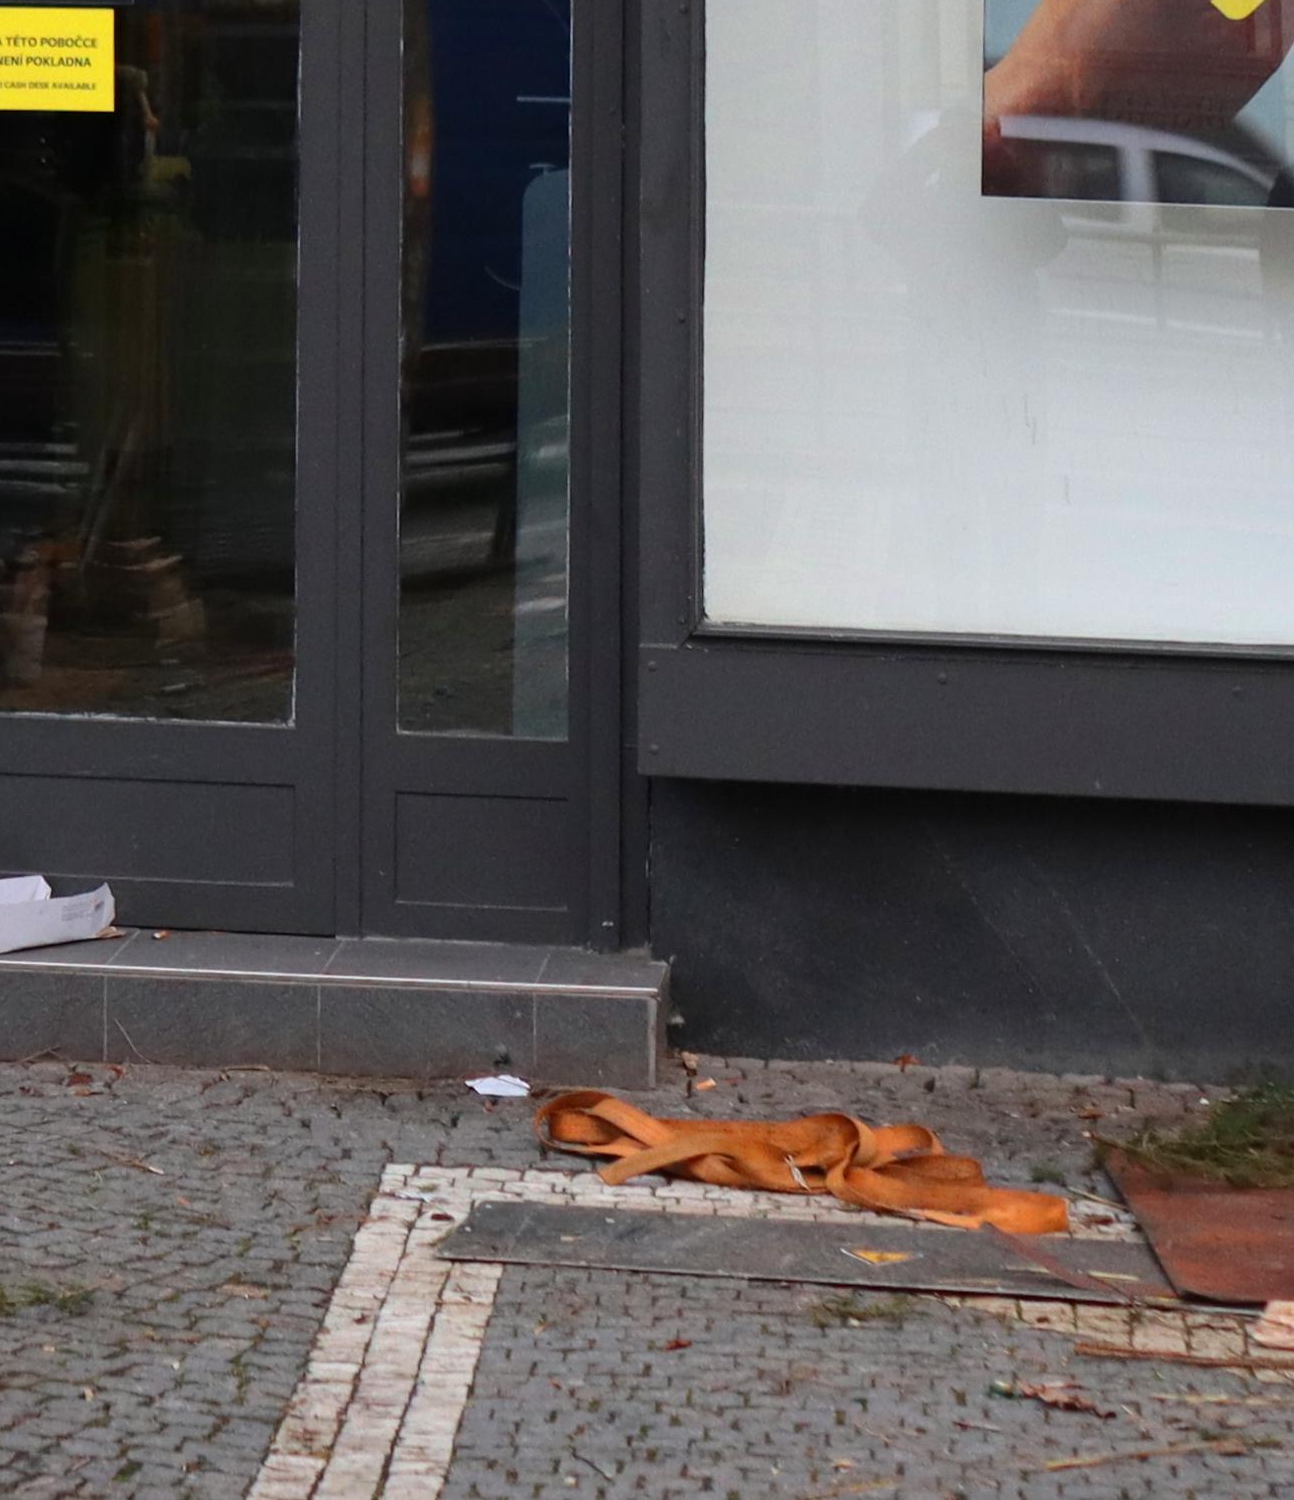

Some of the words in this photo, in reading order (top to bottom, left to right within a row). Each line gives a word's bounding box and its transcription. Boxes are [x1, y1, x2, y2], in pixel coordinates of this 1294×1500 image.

[5, 34, 38, 48] TÉTO
[39, 34, 98, 48] POBOČCE
[25, 56, 92, 67] POKLADNA
